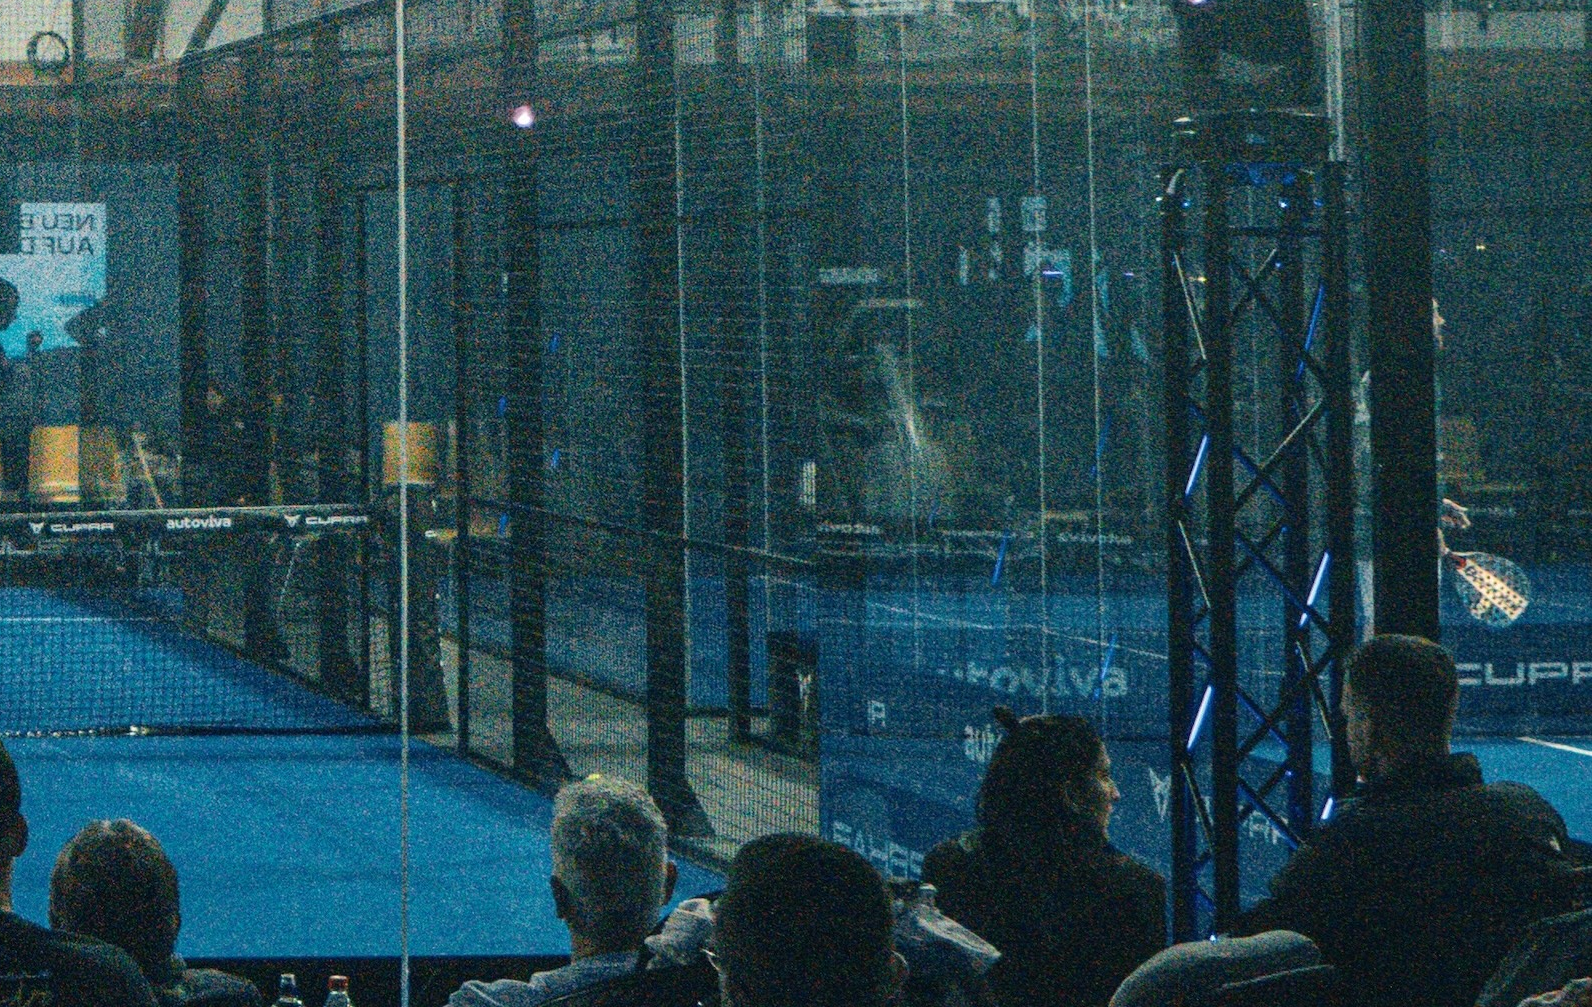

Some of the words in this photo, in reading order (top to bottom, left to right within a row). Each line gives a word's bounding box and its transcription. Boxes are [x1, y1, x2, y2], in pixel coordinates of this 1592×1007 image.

[50, 522, 115, 532] CUPRA
[166, 515, 232, 529] autoviva
[305, 515, 369, 525] CUPRA
